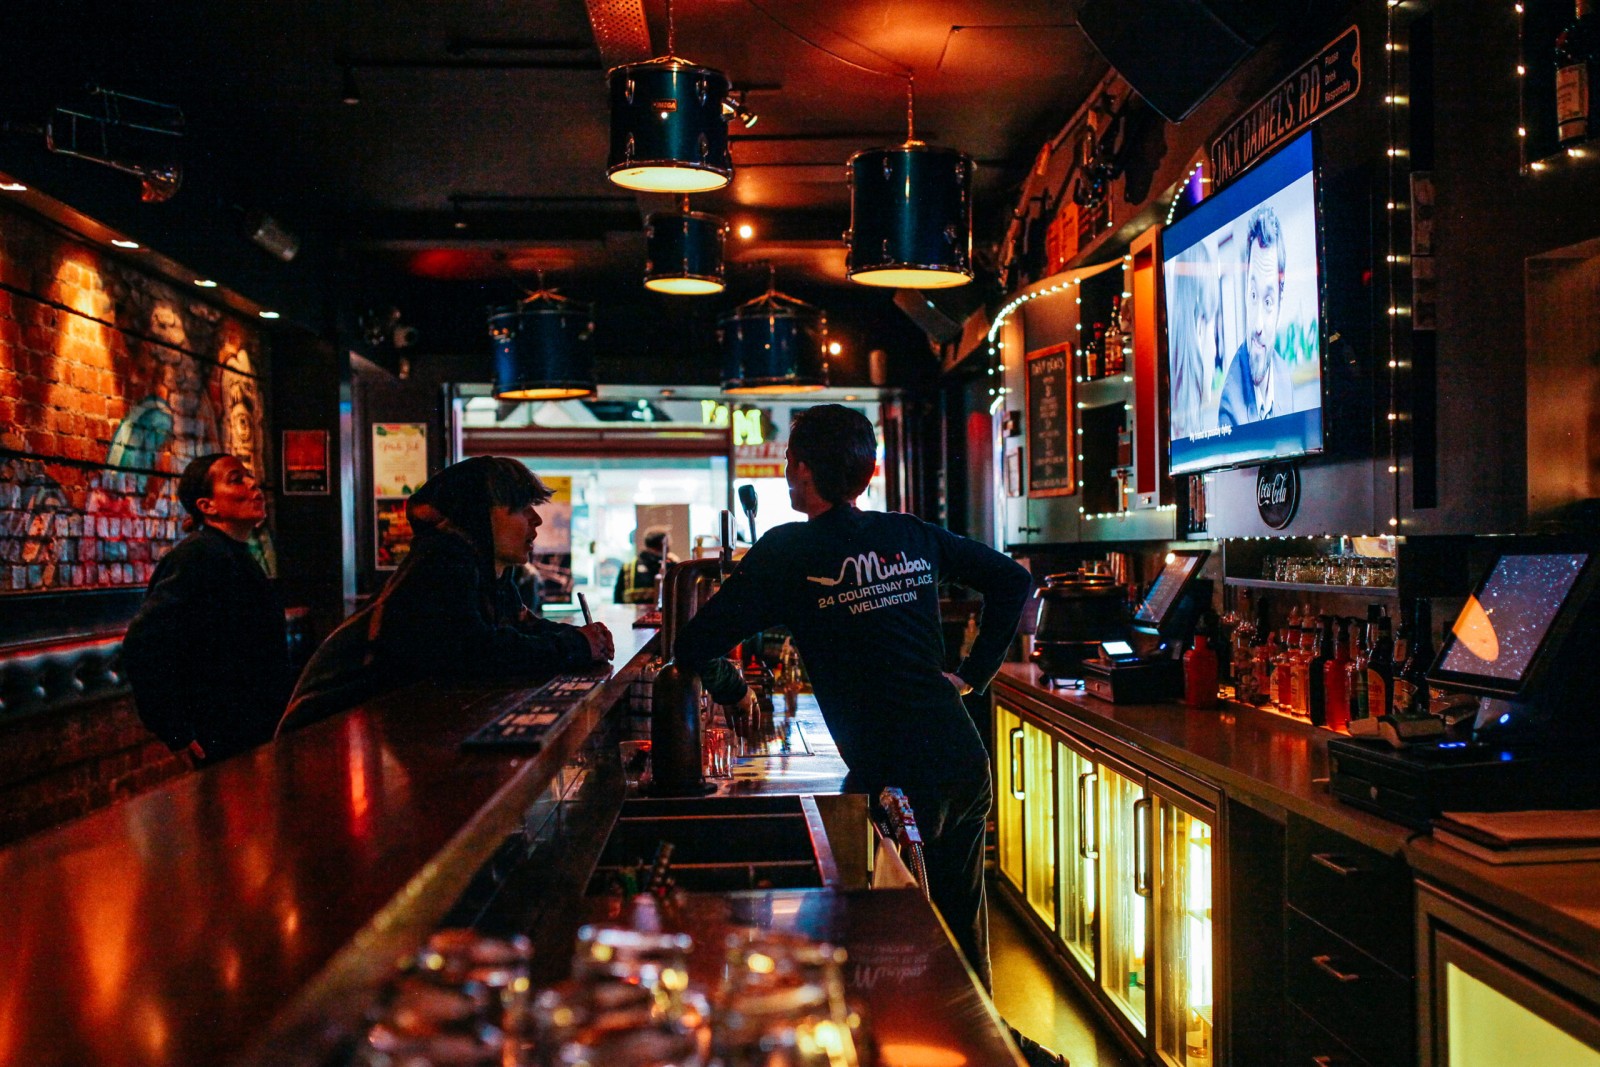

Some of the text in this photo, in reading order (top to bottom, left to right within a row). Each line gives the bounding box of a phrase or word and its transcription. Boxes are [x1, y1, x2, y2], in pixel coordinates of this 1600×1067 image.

[1216, 126, 1241, 187] JACK
[1299, 64, 1321, 122] RD
[836, 550, 931, 587] Minibar
[818, 573, 933, 609] 24 COURTENAY PLACE
[848, 590, 918, 616] WELLINGTON
